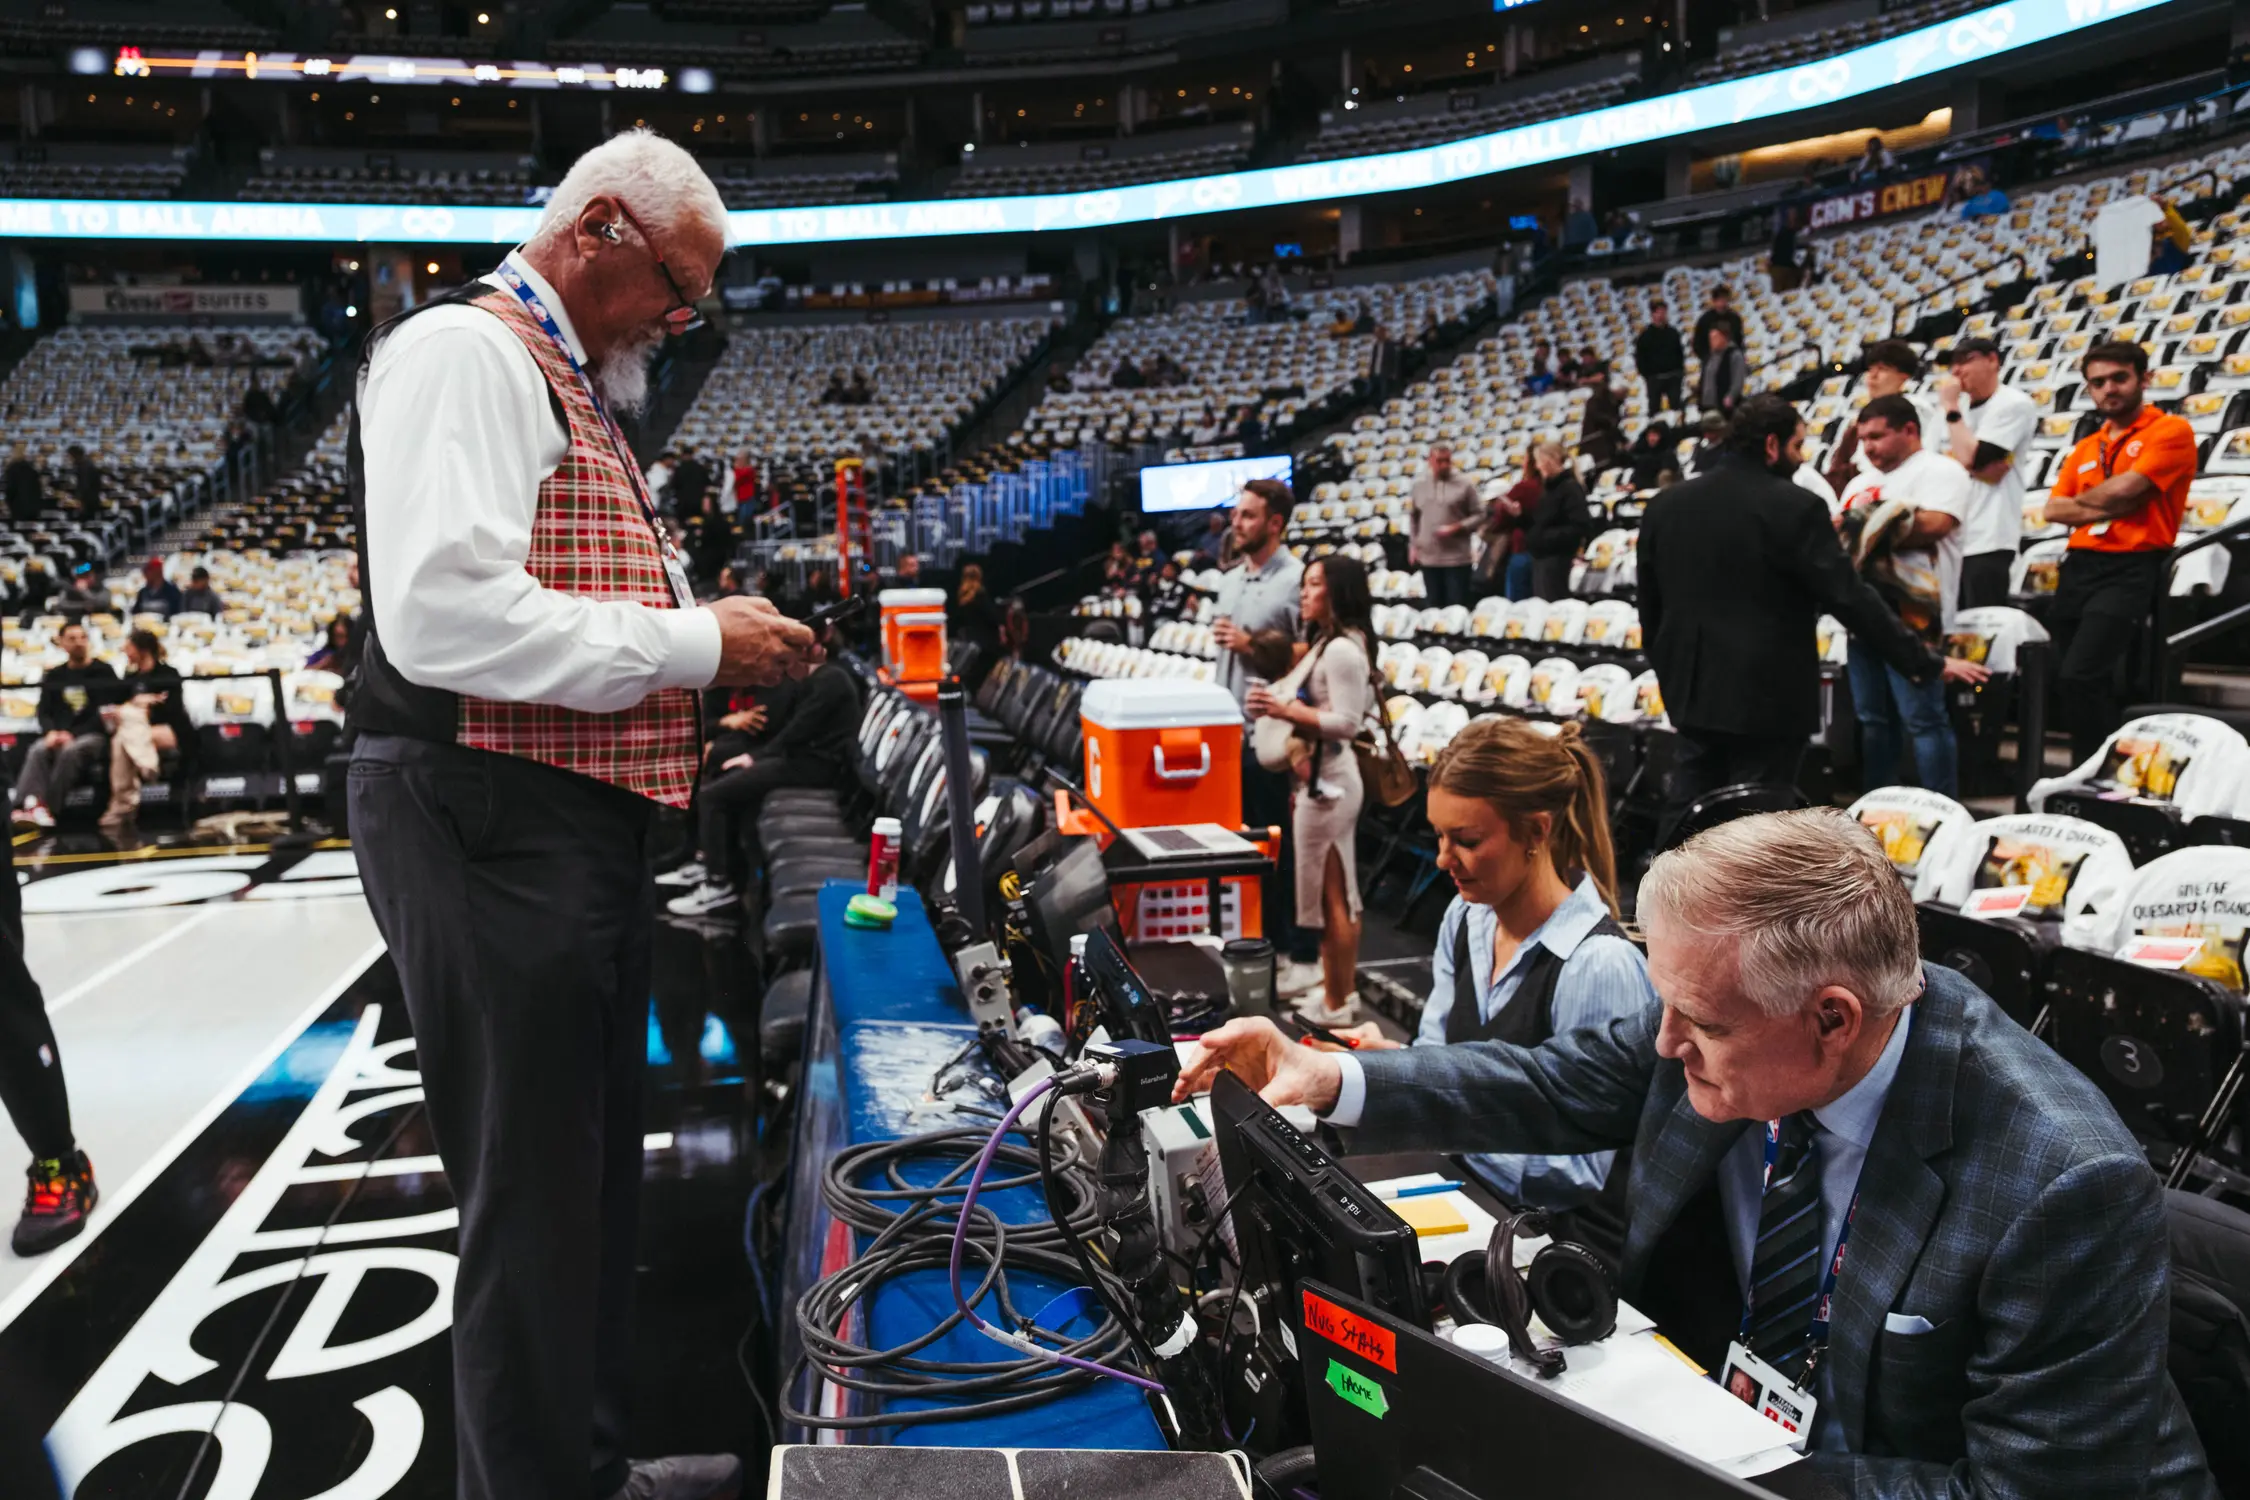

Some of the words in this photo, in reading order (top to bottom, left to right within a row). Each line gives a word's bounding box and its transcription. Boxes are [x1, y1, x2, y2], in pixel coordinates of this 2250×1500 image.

[1272, 152, 1434, 199] WELCOME
[1440, 144, 1482, 176] TO
[1489, 125, 1570, 168] BALL
[1577, 96, 1697, 149] ARENA
[1881, 173, 1948, 213] CREW
[60, 204, 110, 233] TO
[117, 205, 204, 234] BALL
[210, 206, 326, 236] ARENA
[777, 211, 820, 239] TO
[826, 208, 900, 236] BALL
[905, 201, 1006, 233] ARENA
[2118, 1039, 2141, 1073] 3
[1140, 1072, 1168, 1086] Marshall
